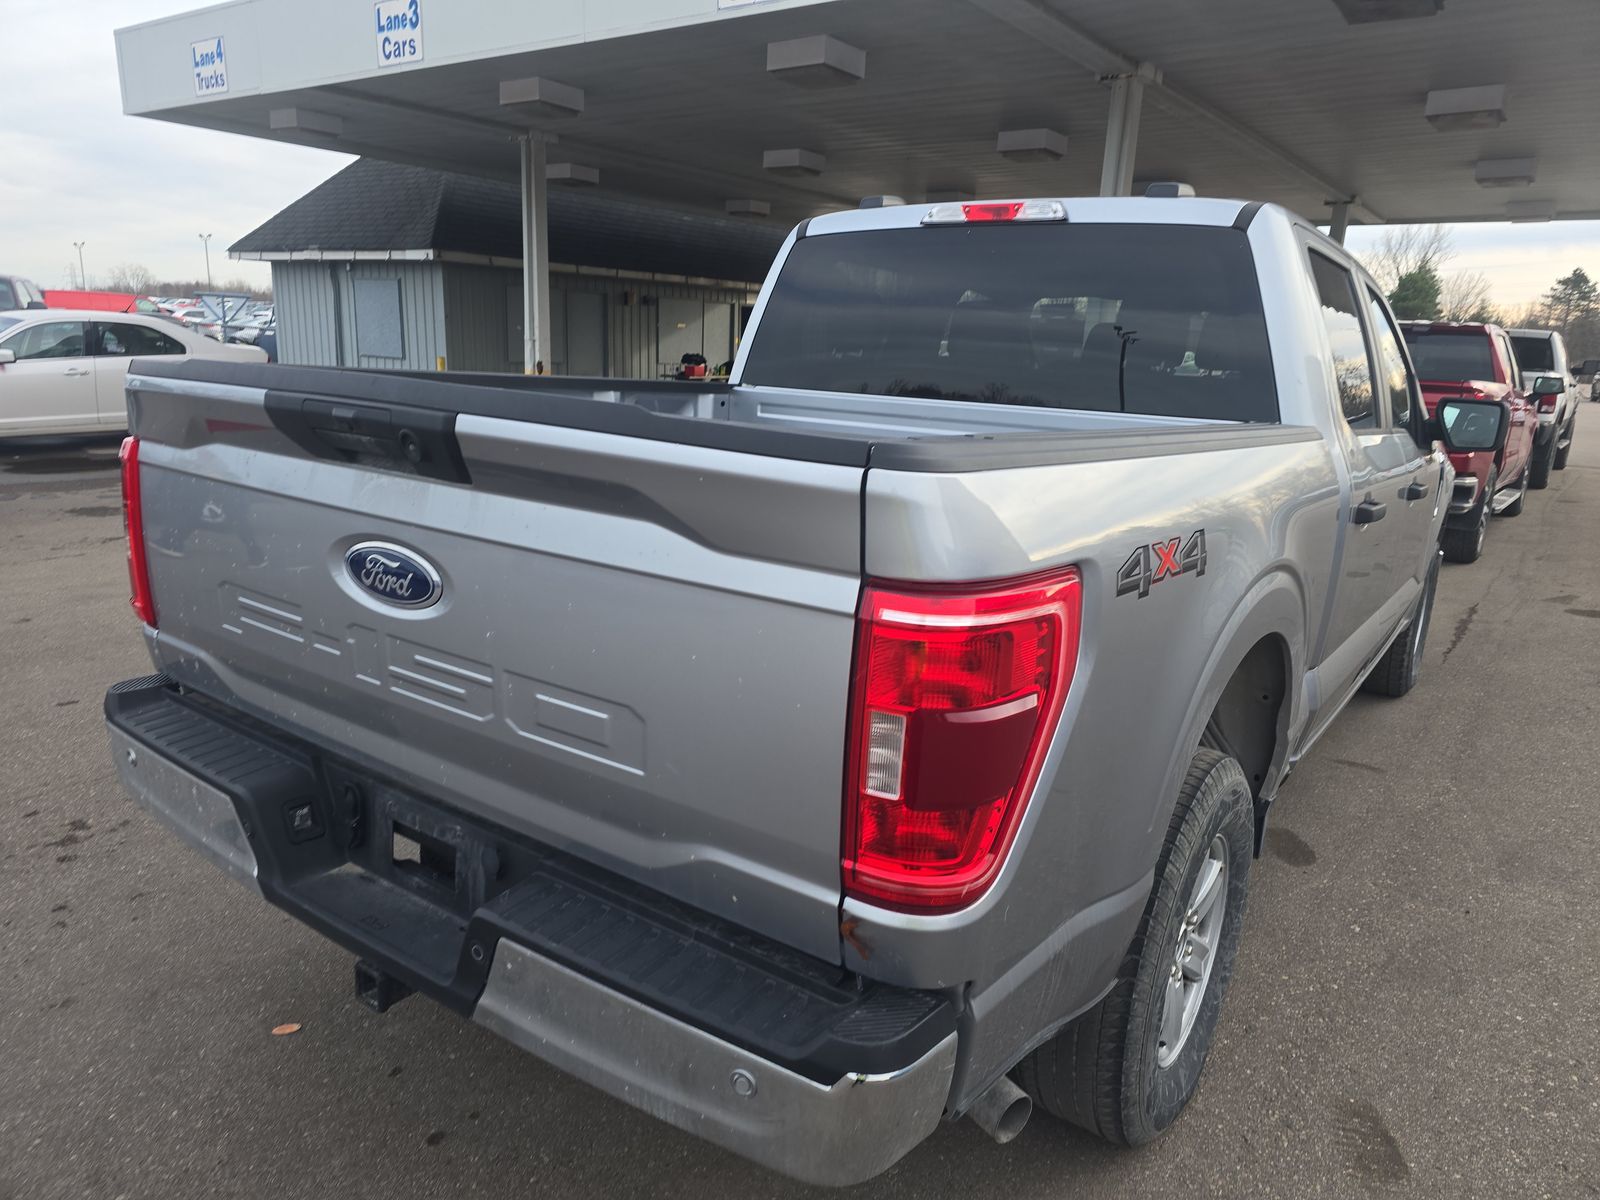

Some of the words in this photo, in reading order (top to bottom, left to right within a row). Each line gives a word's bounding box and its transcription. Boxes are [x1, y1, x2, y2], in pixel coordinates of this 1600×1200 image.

[382, 36, 417, 60] Cars
[195, 70, 225, 91] Trucks
[361, 553, 414, 597] Ford
